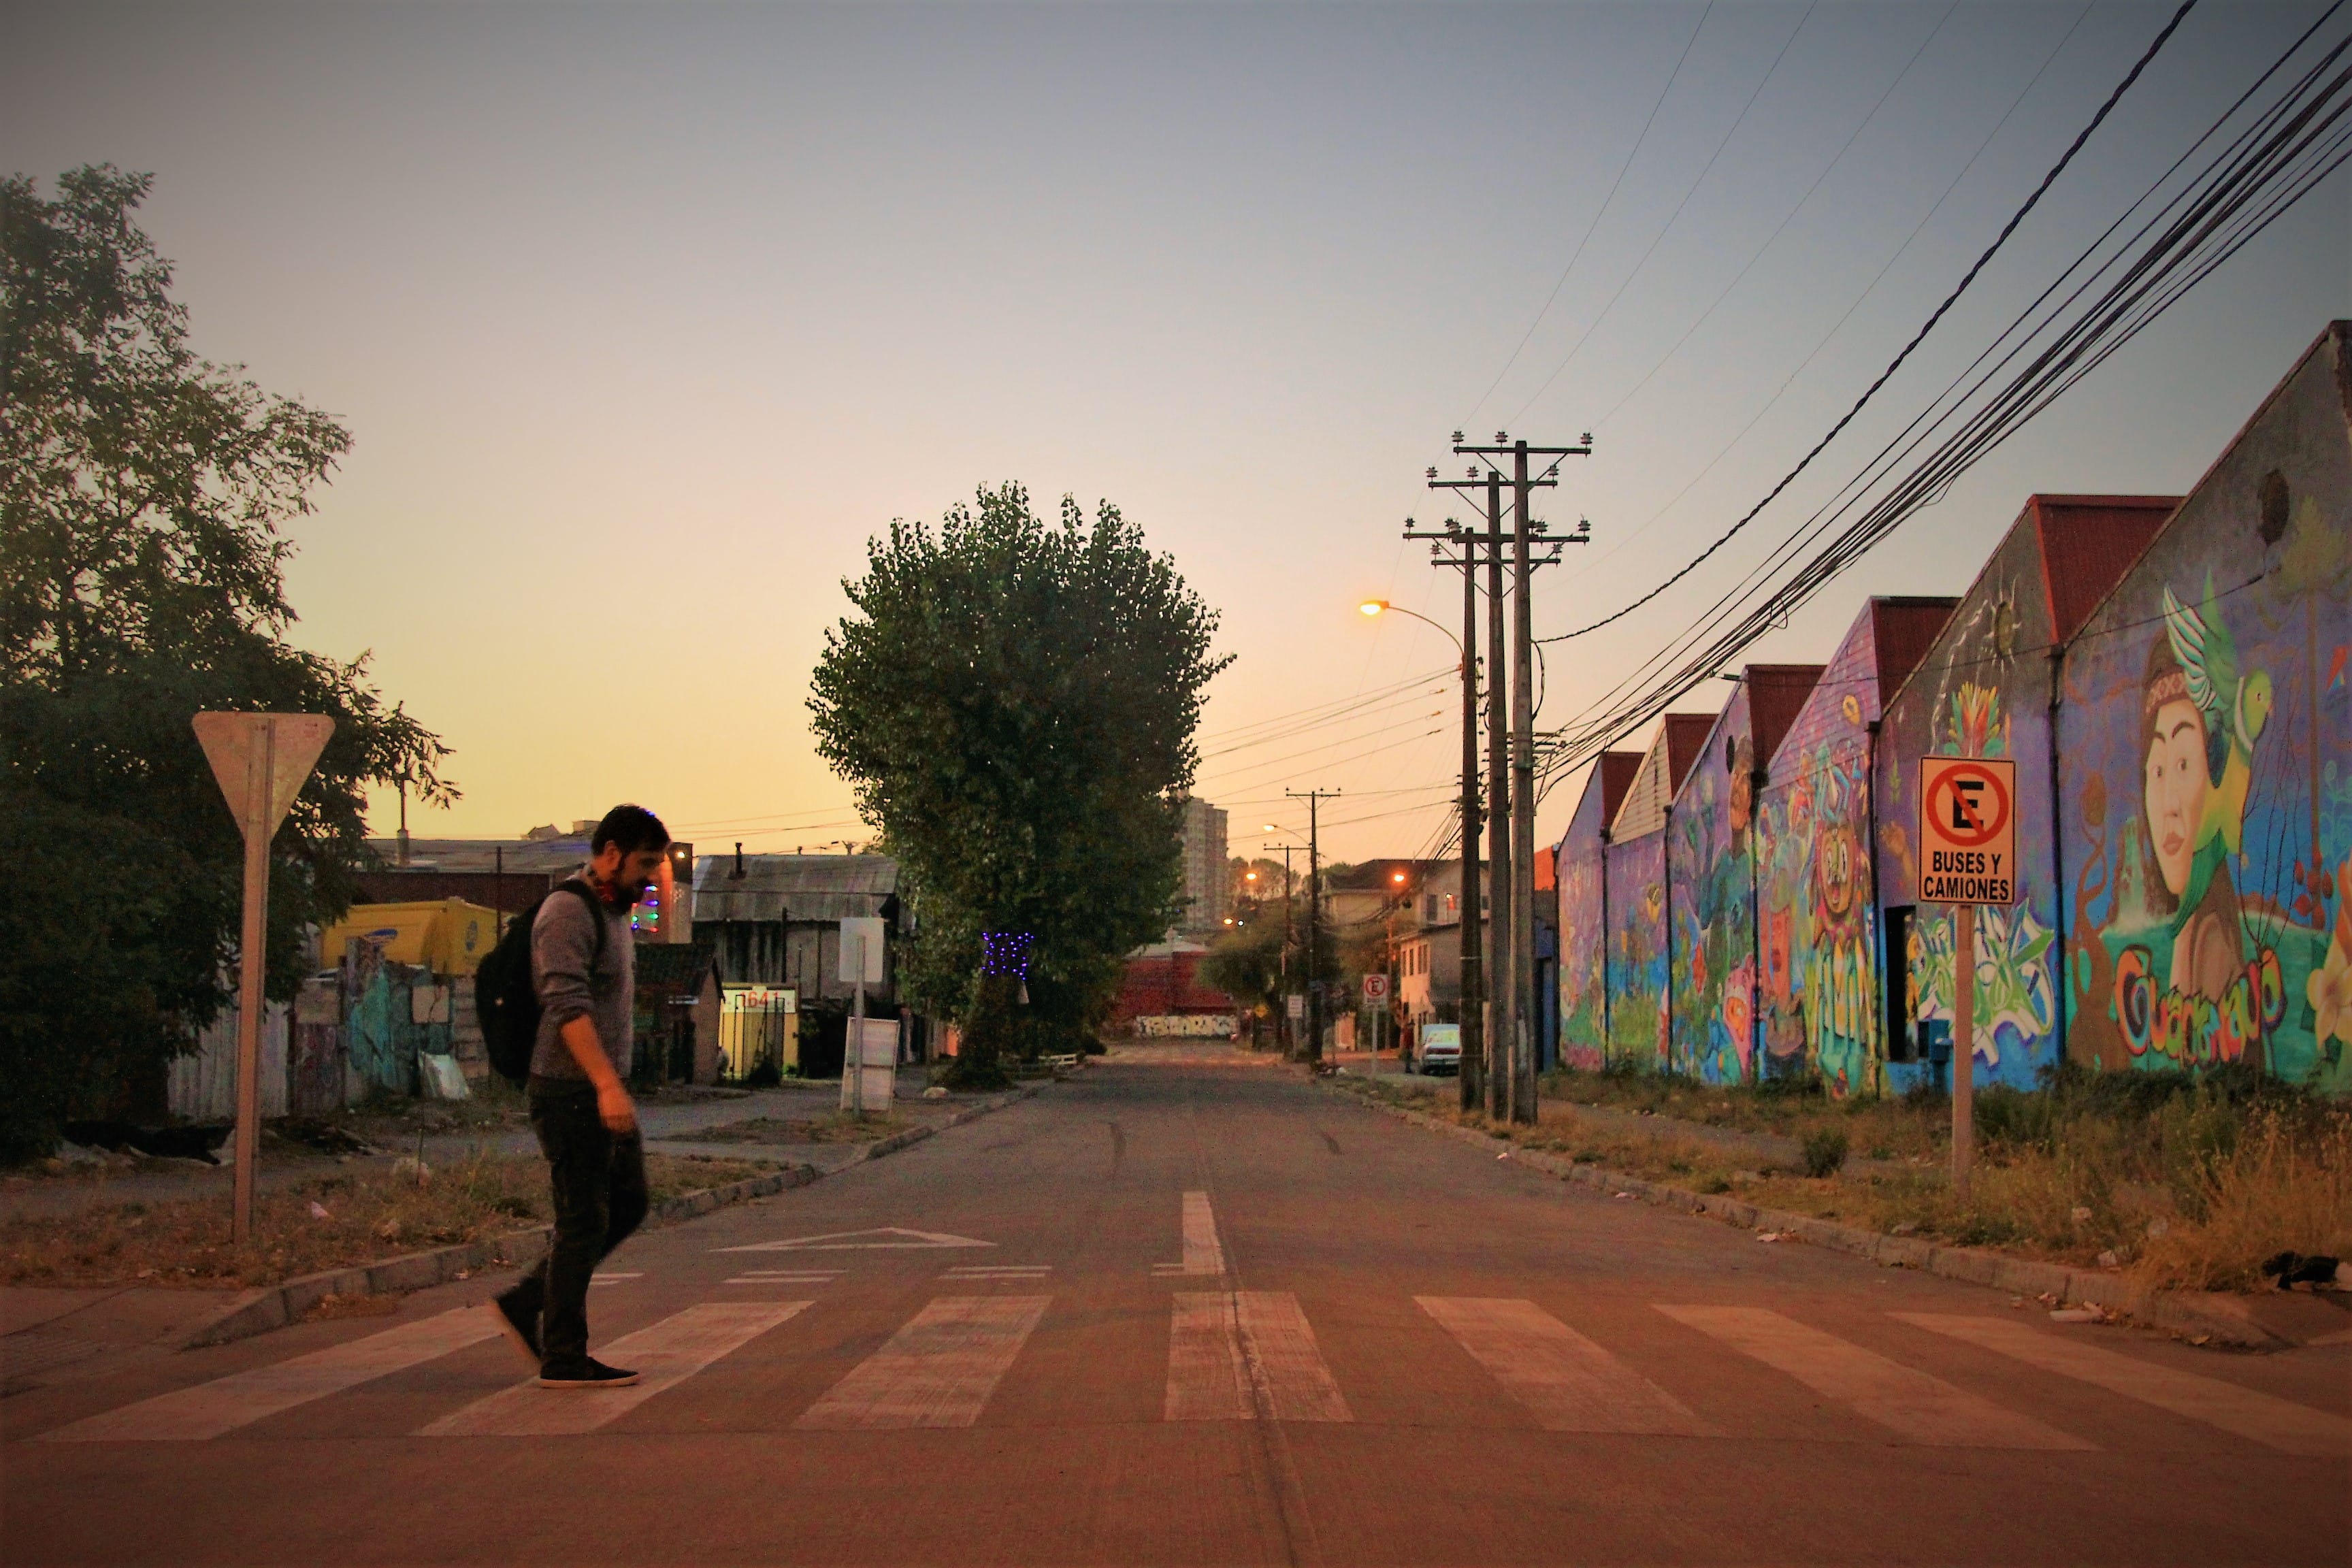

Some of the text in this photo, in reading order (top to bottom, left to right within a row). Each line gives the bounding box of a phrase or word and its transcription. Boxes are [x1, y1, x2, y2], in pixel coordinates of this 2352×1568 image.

[1953, 780, 1984, 829] E
[1933, 851, 2002, 875] BUSES Y
[1924, 876, 2008, 900] CAMIONES
